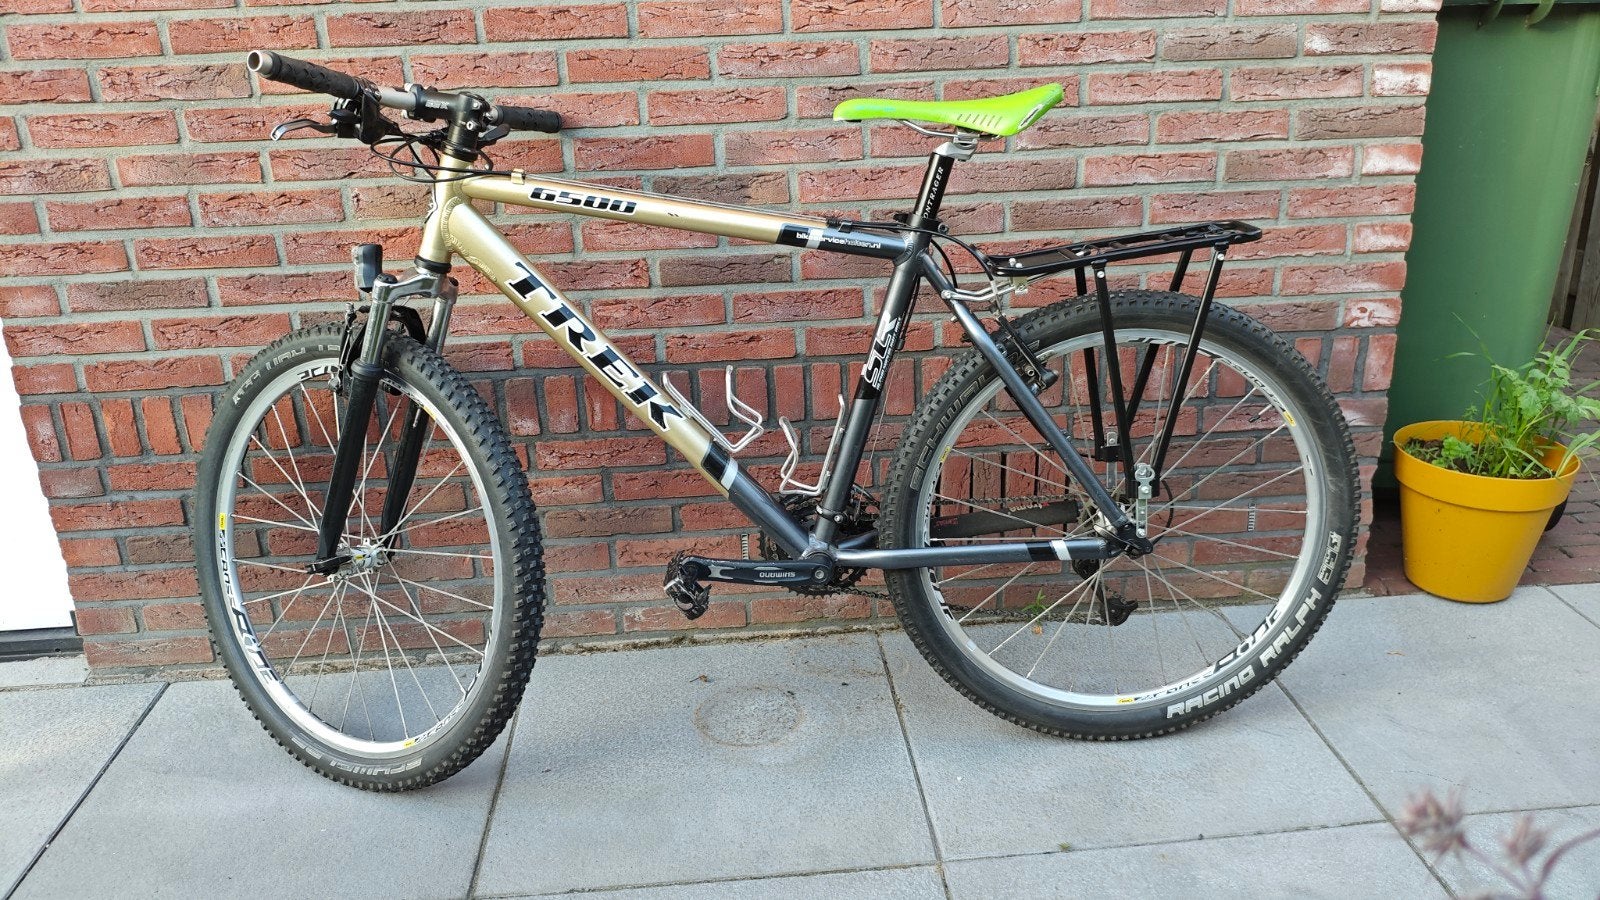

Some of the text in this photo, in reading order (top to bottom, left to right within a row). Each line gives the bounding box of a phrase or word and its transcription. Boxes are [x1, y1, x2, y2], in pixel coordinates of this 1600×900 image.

[528, 187, 637, 215] 6500
[922, 166, 944, 219] ONTRAGER
[504, 261, 686, 431] TREK
[1259, 587, 1322, 667] RALPH
